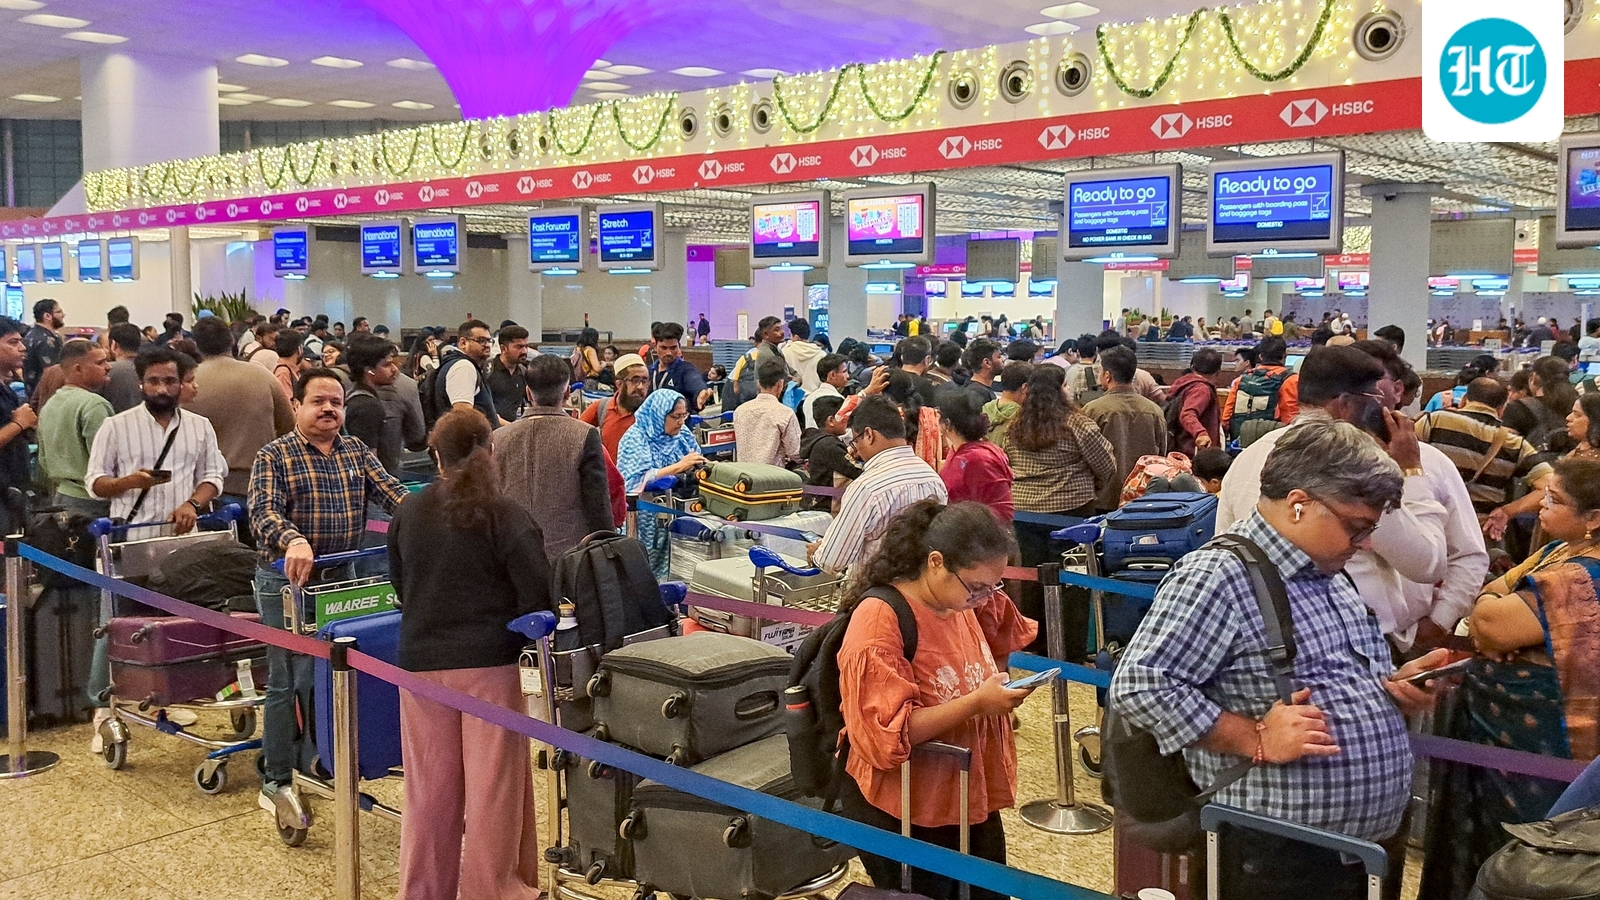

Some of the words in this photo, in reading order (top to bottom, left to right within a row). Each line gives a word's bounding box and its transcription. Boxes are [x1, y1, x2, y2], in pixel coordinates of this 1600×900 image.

[1332, 100, 1374, 116] HSBC
[1196, 114, 1233, 129] HSBC
[1077, 127, 1110, 141] HSBC
[974, 138, 1003, 151] HSBC
[881, 147, 907, 159] HSBC
[798, 155, 822, 167] HSBC
[656, 168, 676, 178] HSBC
[724, 162, 745, 173] HSBC
[536, 179, 553, 188] HSBC
[593, 173, 612, 183] HSBC
[483, 183, 499, 193] HSBC
[1219, 175, 1271, 196] Ready
[1273, 176, 1291, 191] to
[1293, 176, 1317, 194] go
[435, 188, 449, 197] HSBC
[1074, 186, 1118, 205] Ready
[1119, 187, 1134, 200] to
[1136, 187, 1156, 204] go
[1219, 203, 1252, 211] Passengers
[1252, 201, 1265, 209] with
[1265, 201, 1292, 209] boarding
[1293, 200, 1308, 208] pass
[1231, 210, 1257, 218] baggage
[1258, 209, 1272, 217] tags
[532, 222, 545, 231] Fast
[545, 221, 571, 231] Forward
[602, 218, 628, 229] Stretch
[363, 228, 398, 241] International
[416, 226, 455, 239] International
[325, 595, 380, 615] WAAREE
